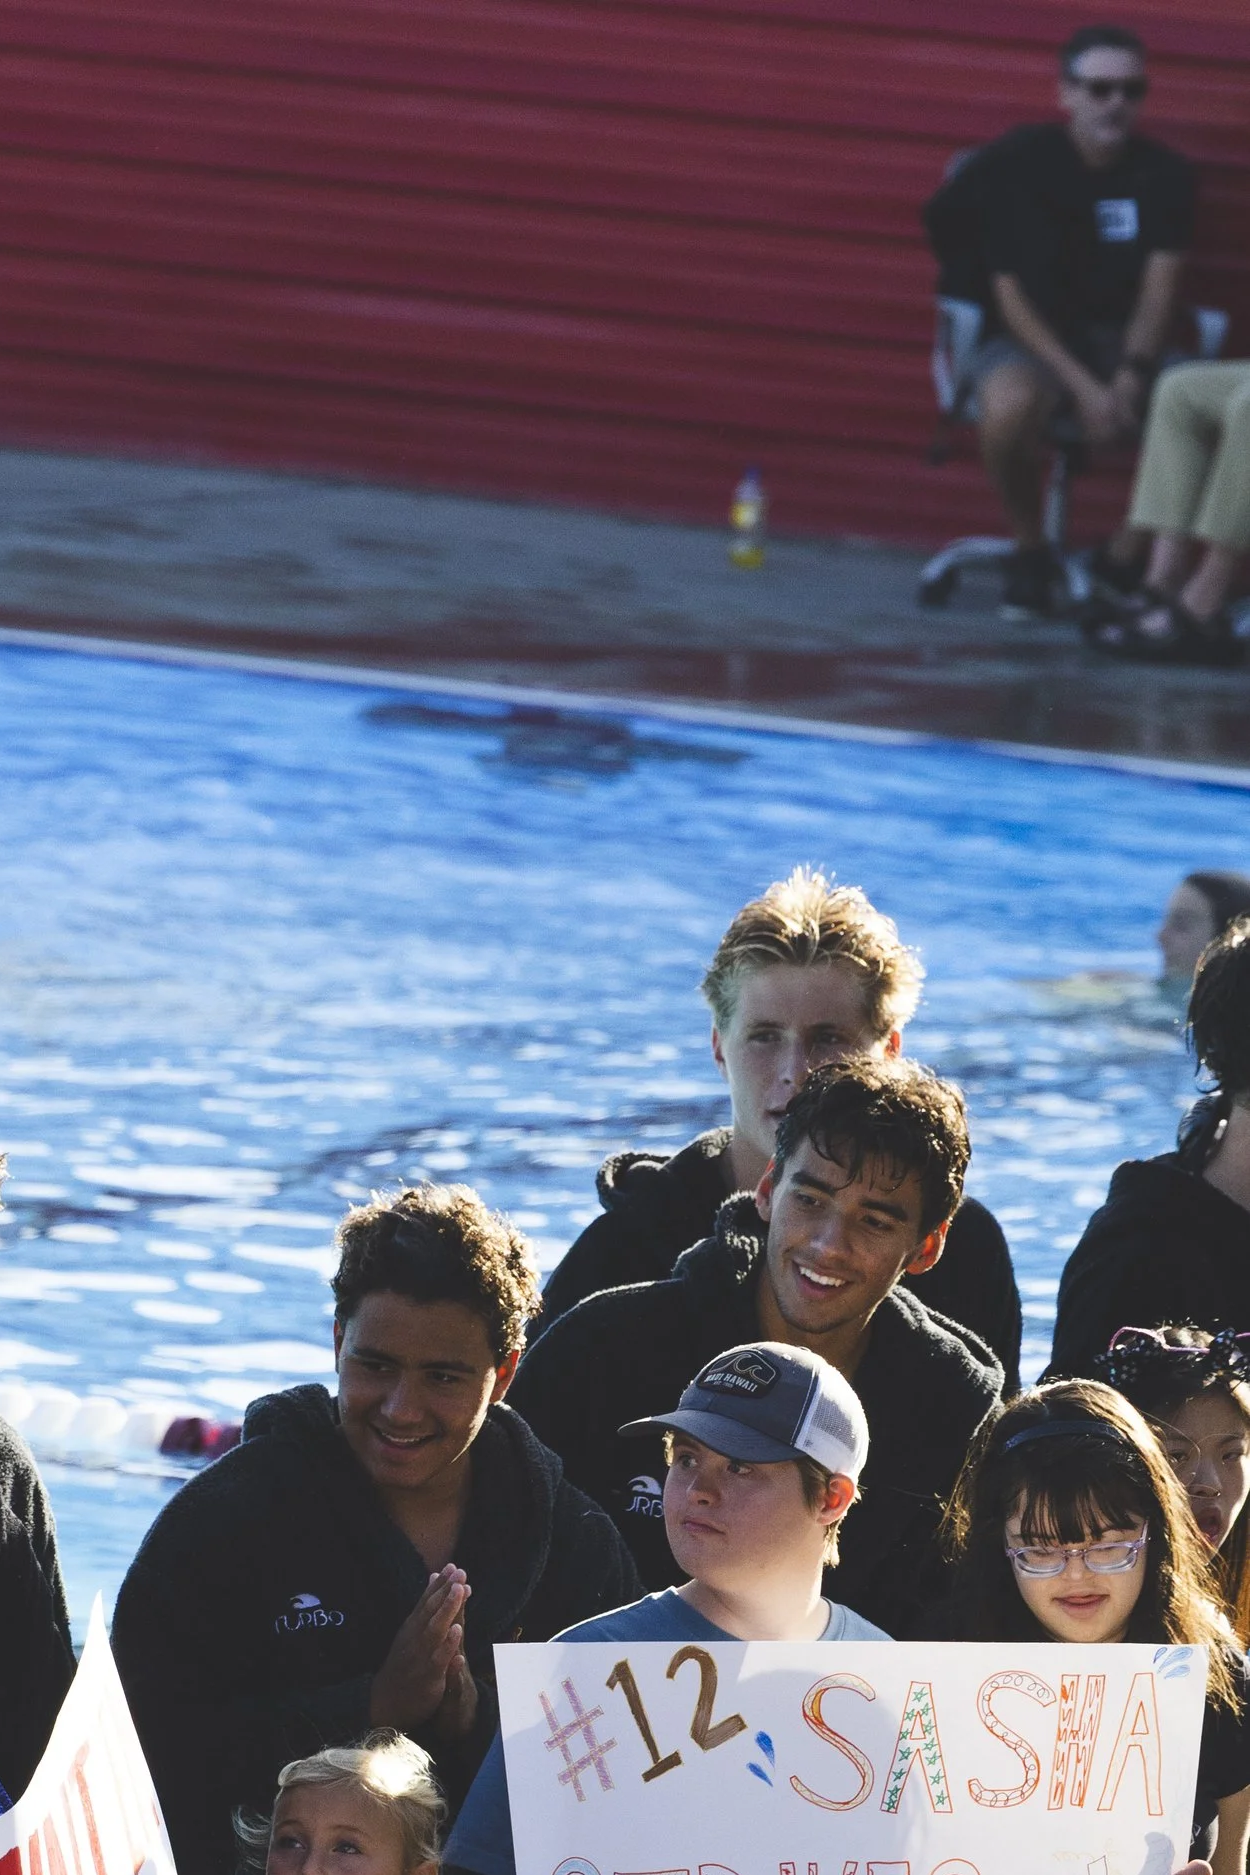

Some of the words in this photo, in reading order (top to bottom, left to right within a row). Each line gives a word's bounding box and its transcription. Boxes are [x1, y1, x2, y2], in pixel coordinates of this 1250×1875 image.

[724, 1373, 758, 1393] HAWAII
[539, 1645, 746, 1802] #12
[789, 1671, 1164, 1815] SASHA
